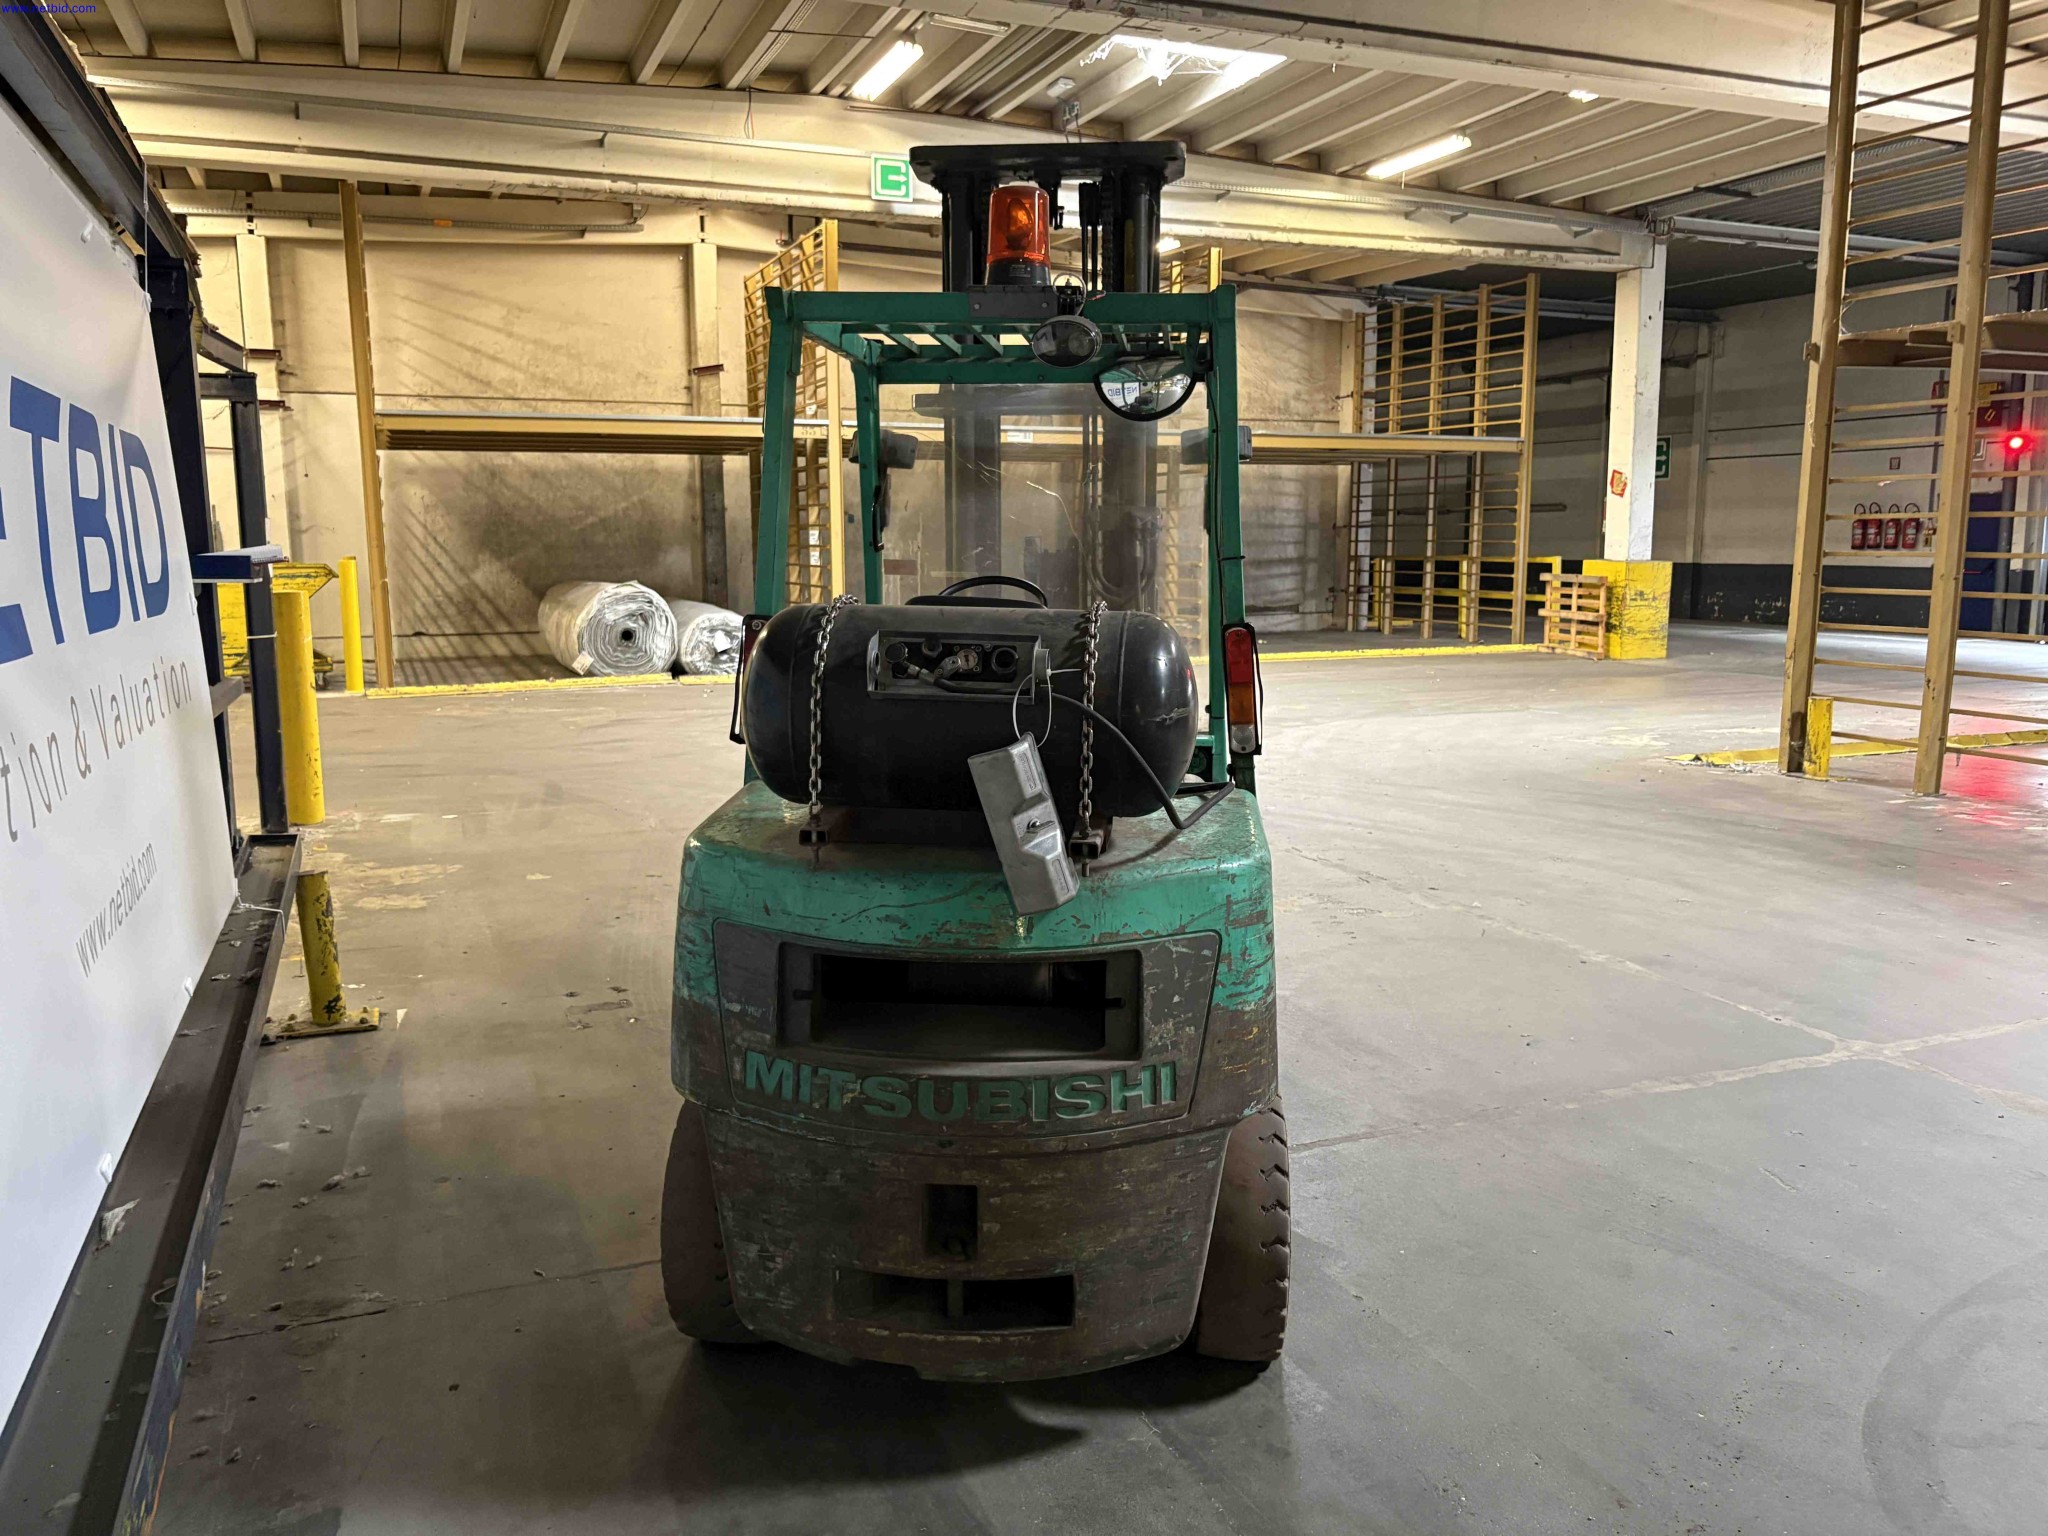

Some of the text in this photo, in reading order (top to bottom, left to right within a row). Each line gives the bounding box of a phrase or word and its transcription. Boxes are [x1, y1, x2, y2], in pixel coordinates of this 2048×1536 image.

[0, 655, 192, 843] tion & Valuation
[75, 842, 158, 978] www.netbid.com
[744, 1049, 1177, 1122] MITSUBISHI
